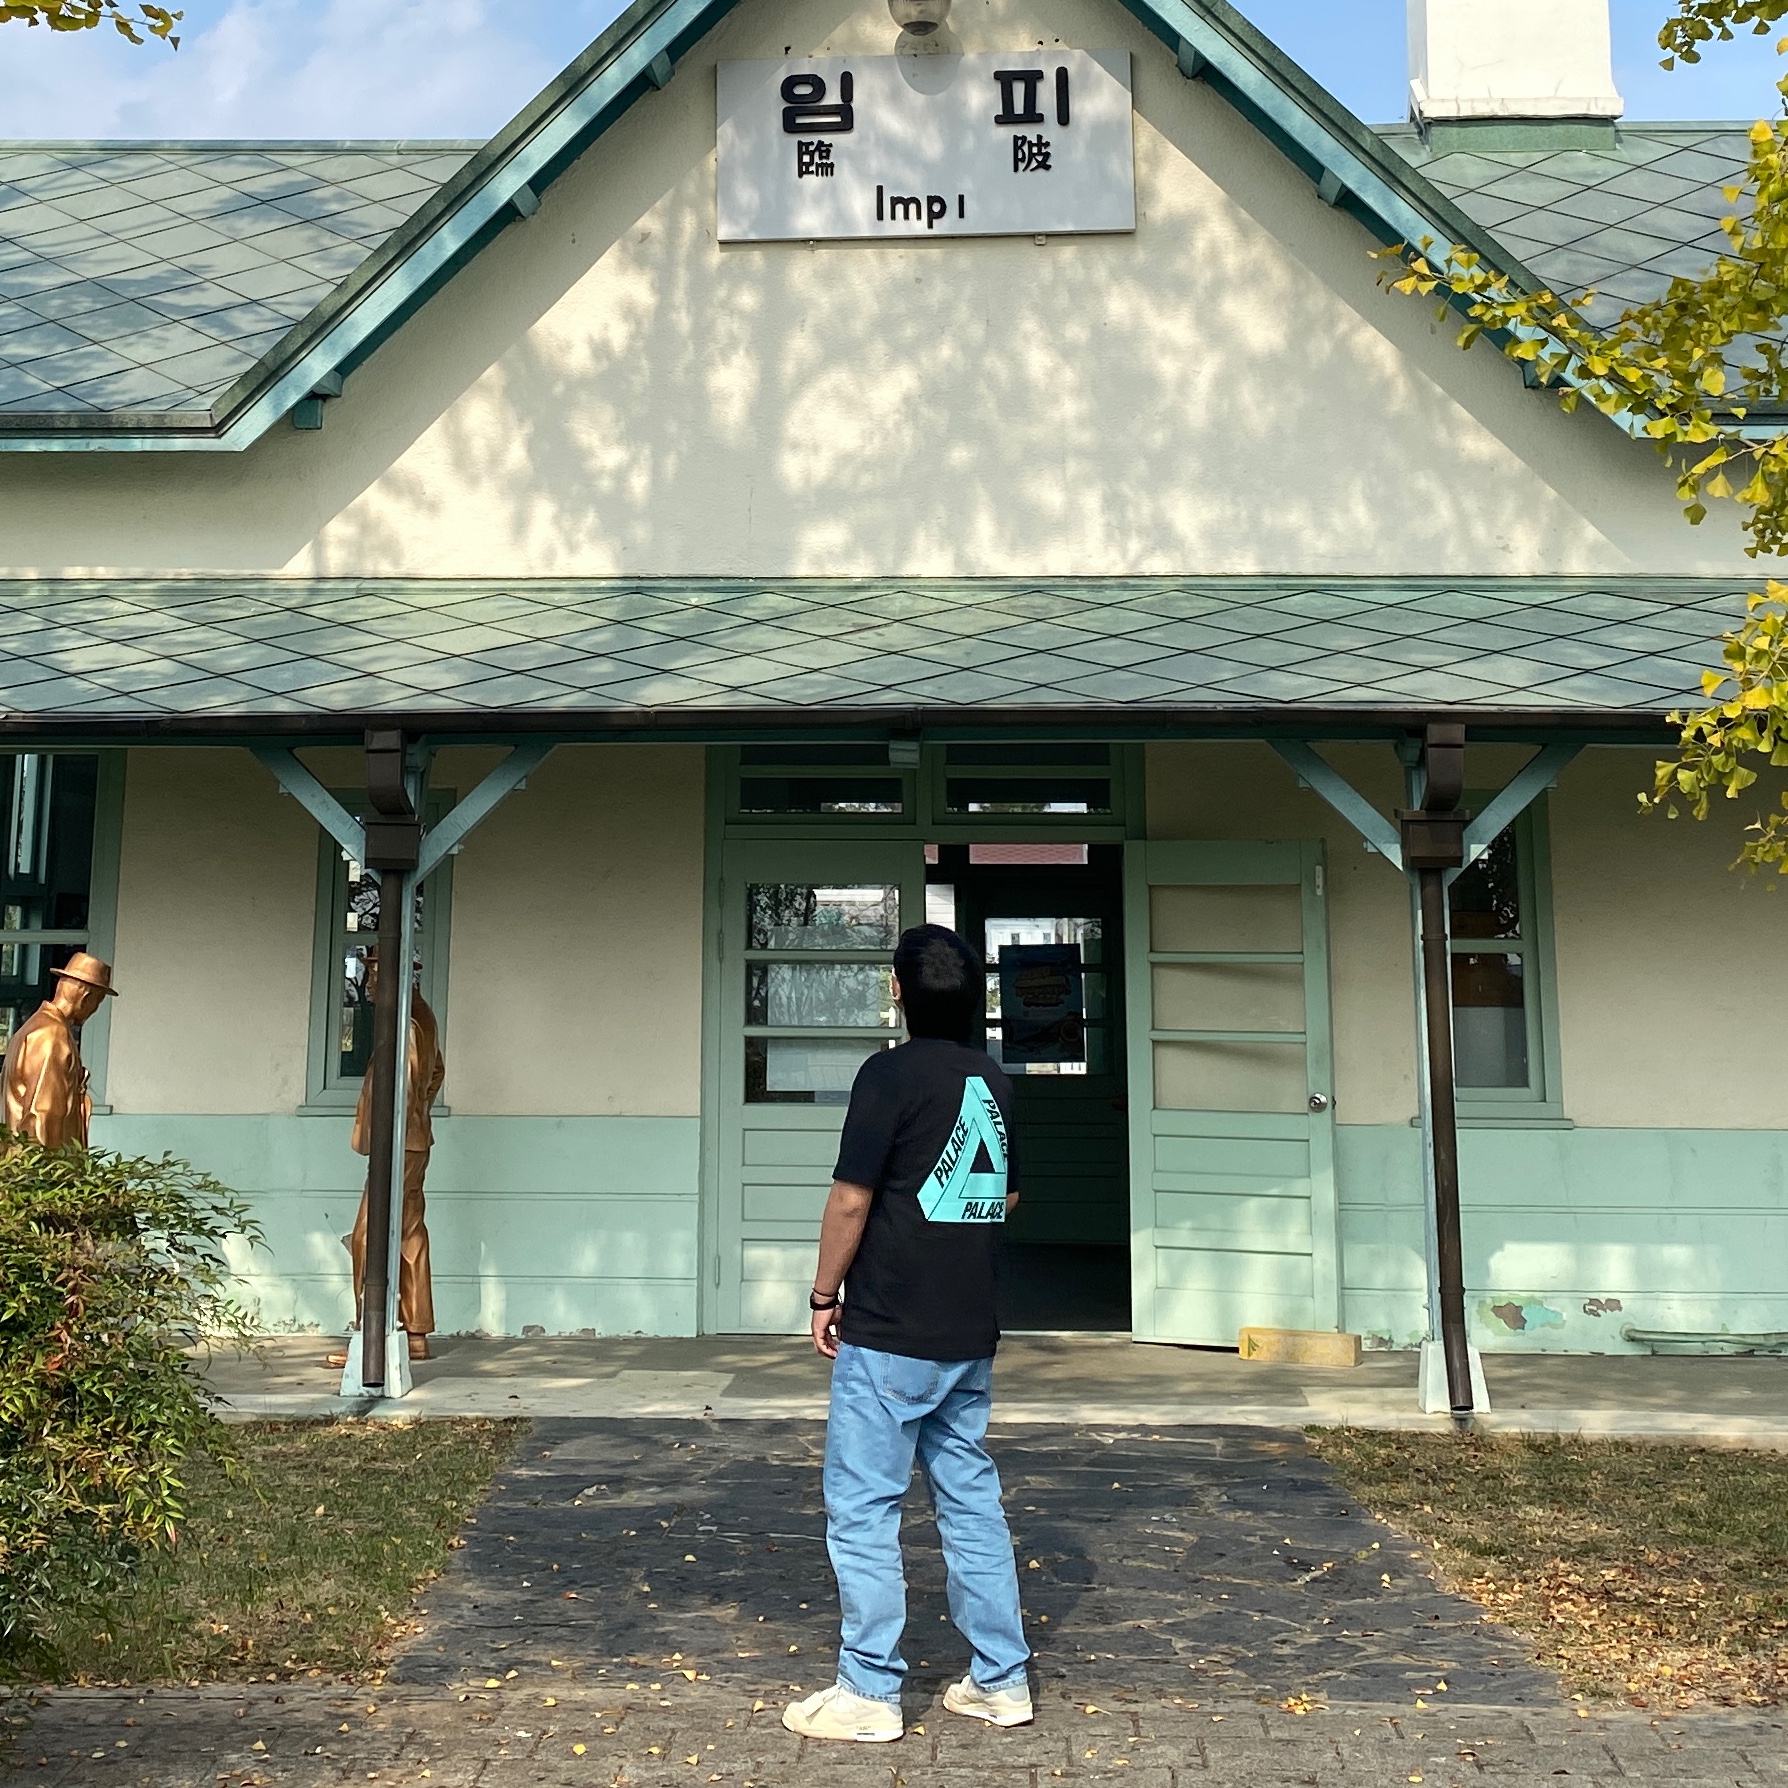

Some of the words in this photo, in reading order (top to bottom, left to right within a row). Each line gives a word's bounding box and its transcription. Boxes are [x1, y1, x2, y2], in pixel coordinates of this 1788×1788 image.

[780, 70, 854, 133] 임
[993, 66, 1069, 126] 피
[1012, 134, 1052, 173] 陂
[876, 184, 965, 229] Impi
[933, 1115, 969, 1189] PALACE
[961, 1201, 1004, 1220] PALACE
